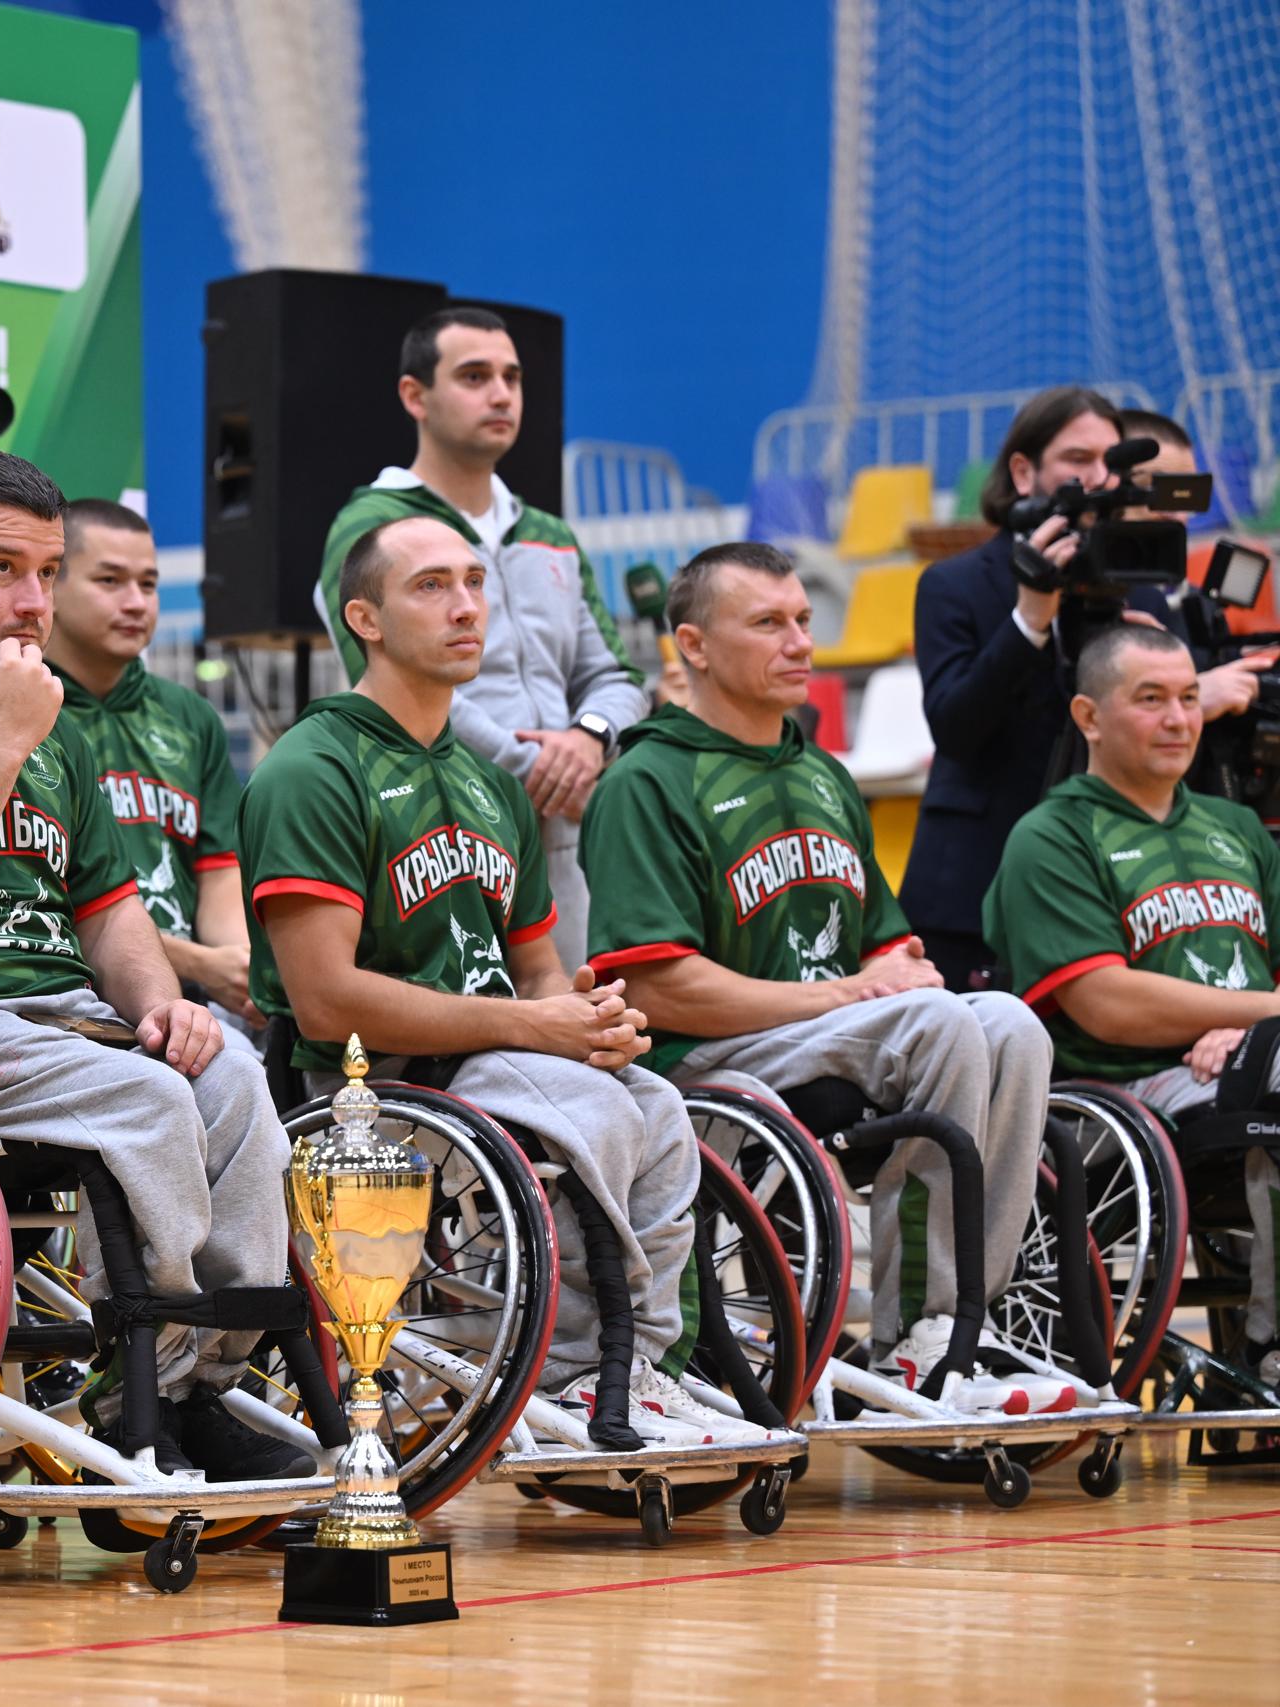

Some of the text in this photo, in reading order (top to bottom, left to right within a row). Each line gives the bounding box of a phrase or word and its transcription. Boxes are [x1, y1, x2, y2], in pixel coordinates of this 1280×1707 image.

[379, 783, 414, 801] MAXX
[713, 796, 747, 814] MAXX
[732, 835, 806, 916] КРЫЛЯ
[407, 1560, 432, 1570] МЕСТО
